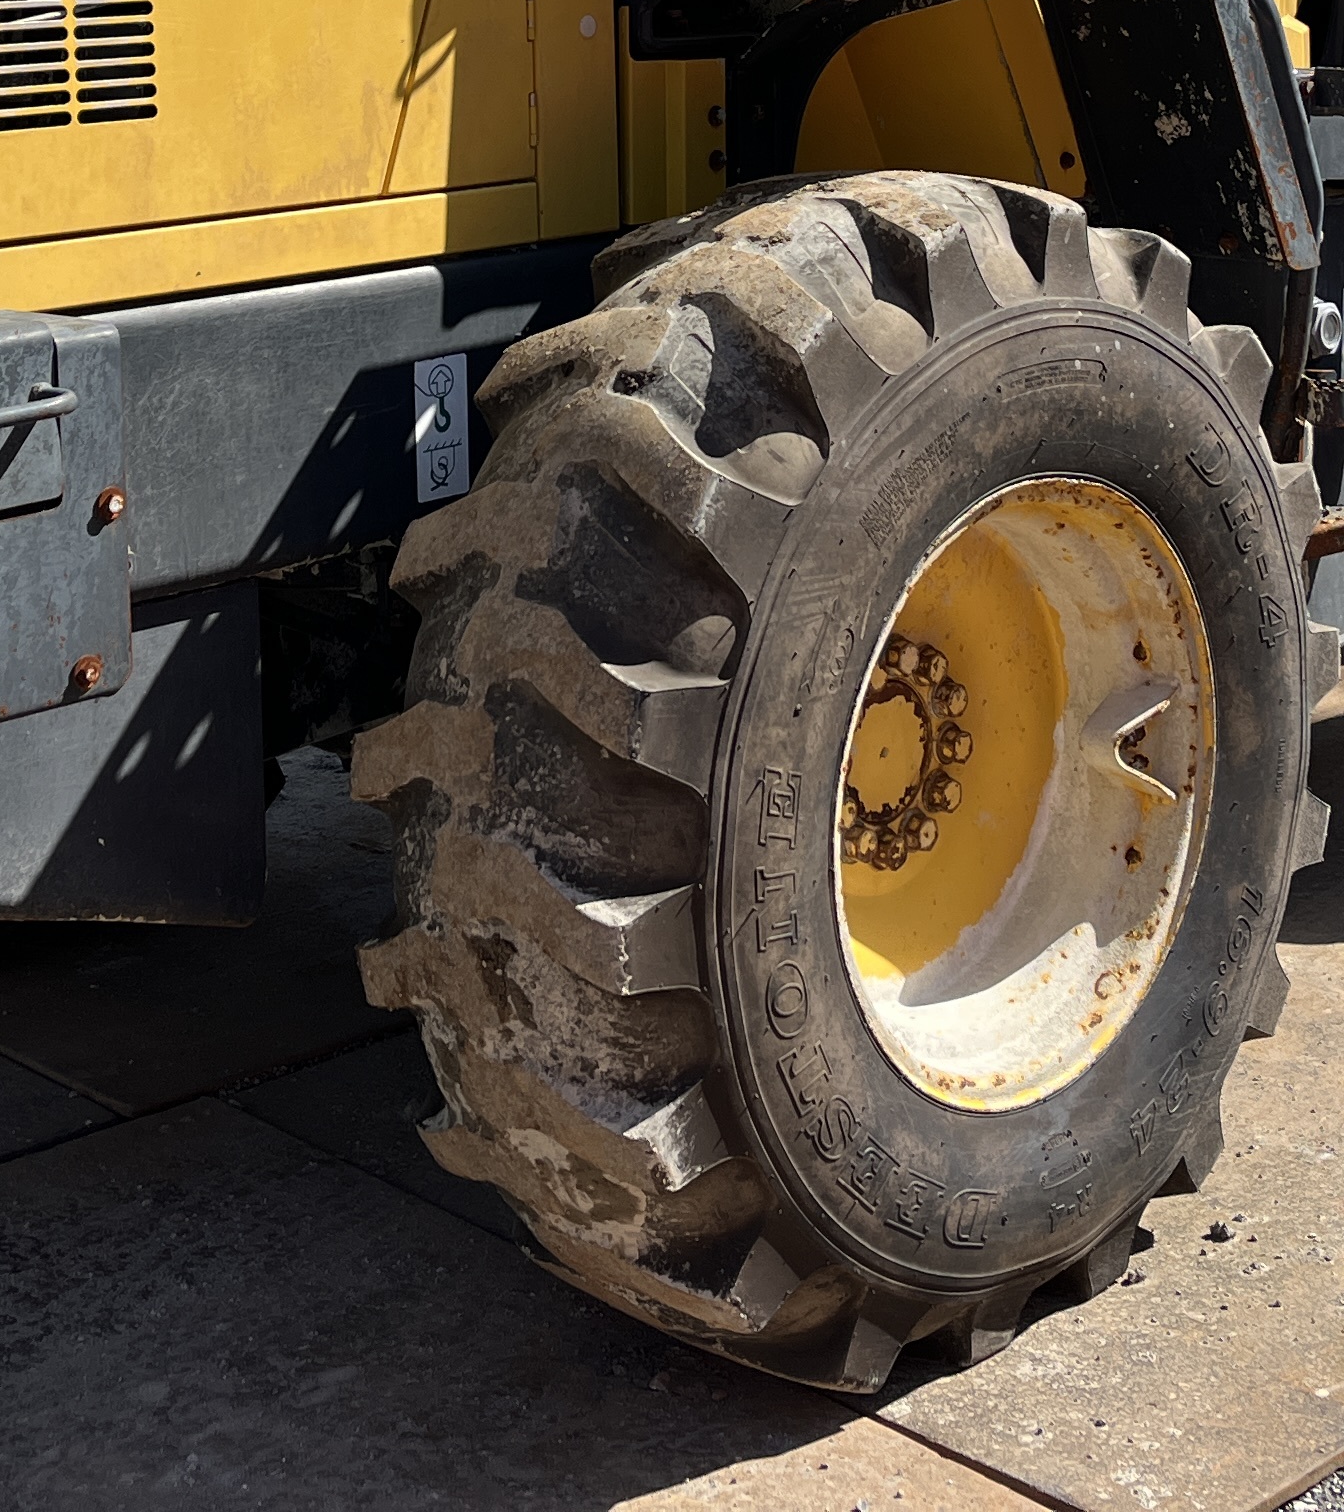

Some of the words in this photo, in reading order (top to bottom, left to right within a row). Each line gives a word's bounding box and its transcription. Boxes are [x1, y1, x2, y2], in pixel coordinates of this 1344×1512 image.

[1184, 421, 1291, 649] DR-4
[748, 765, 1001, 1250] DEESTONE
[1129, 882, 1266, 1158] 16.9-24
